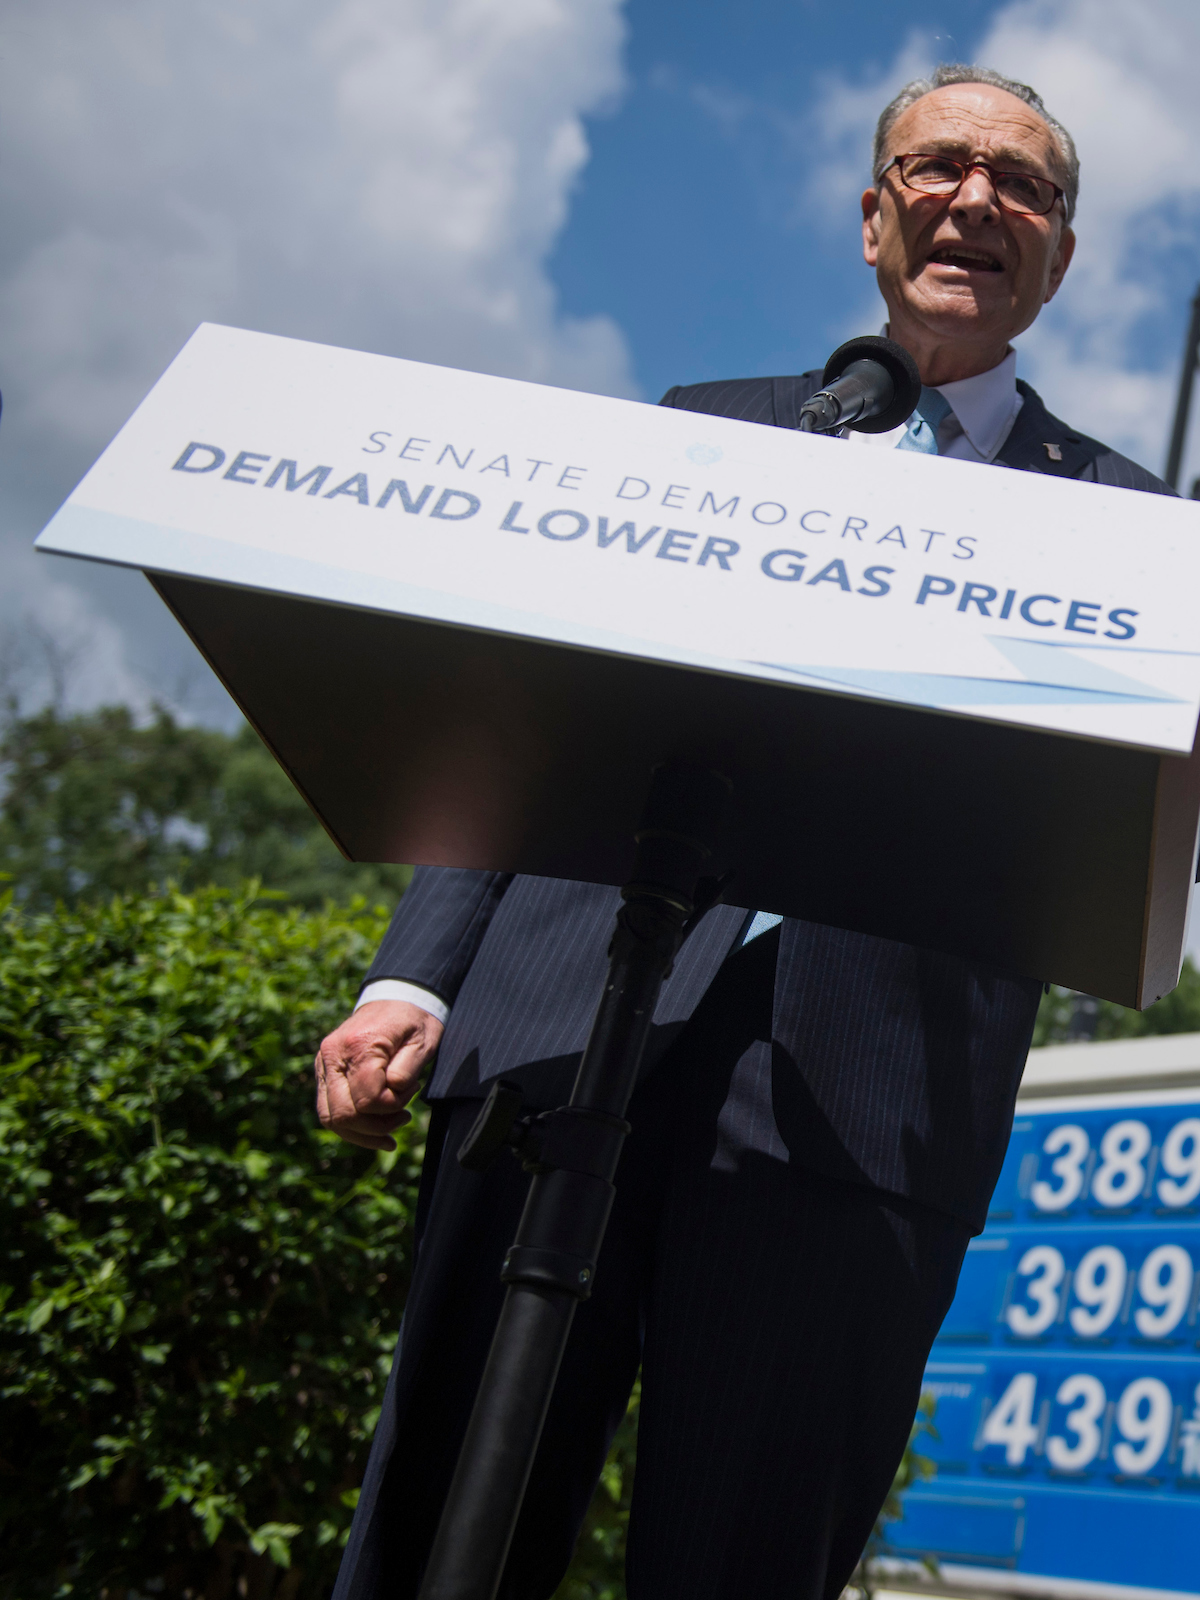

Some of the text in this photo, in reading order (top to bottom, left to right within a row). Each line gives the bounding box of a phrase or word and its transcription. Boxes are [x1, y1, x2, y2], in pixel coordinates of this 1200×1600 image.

[171, 441, 1140, 640] DEMAND LOWER GAS PRICES
[361, 430, 977, 561] SENATE DEMOCRATS
[1006, 1244, 1194, 1337] 399
[983, 1372, 1173, 1474] 439
